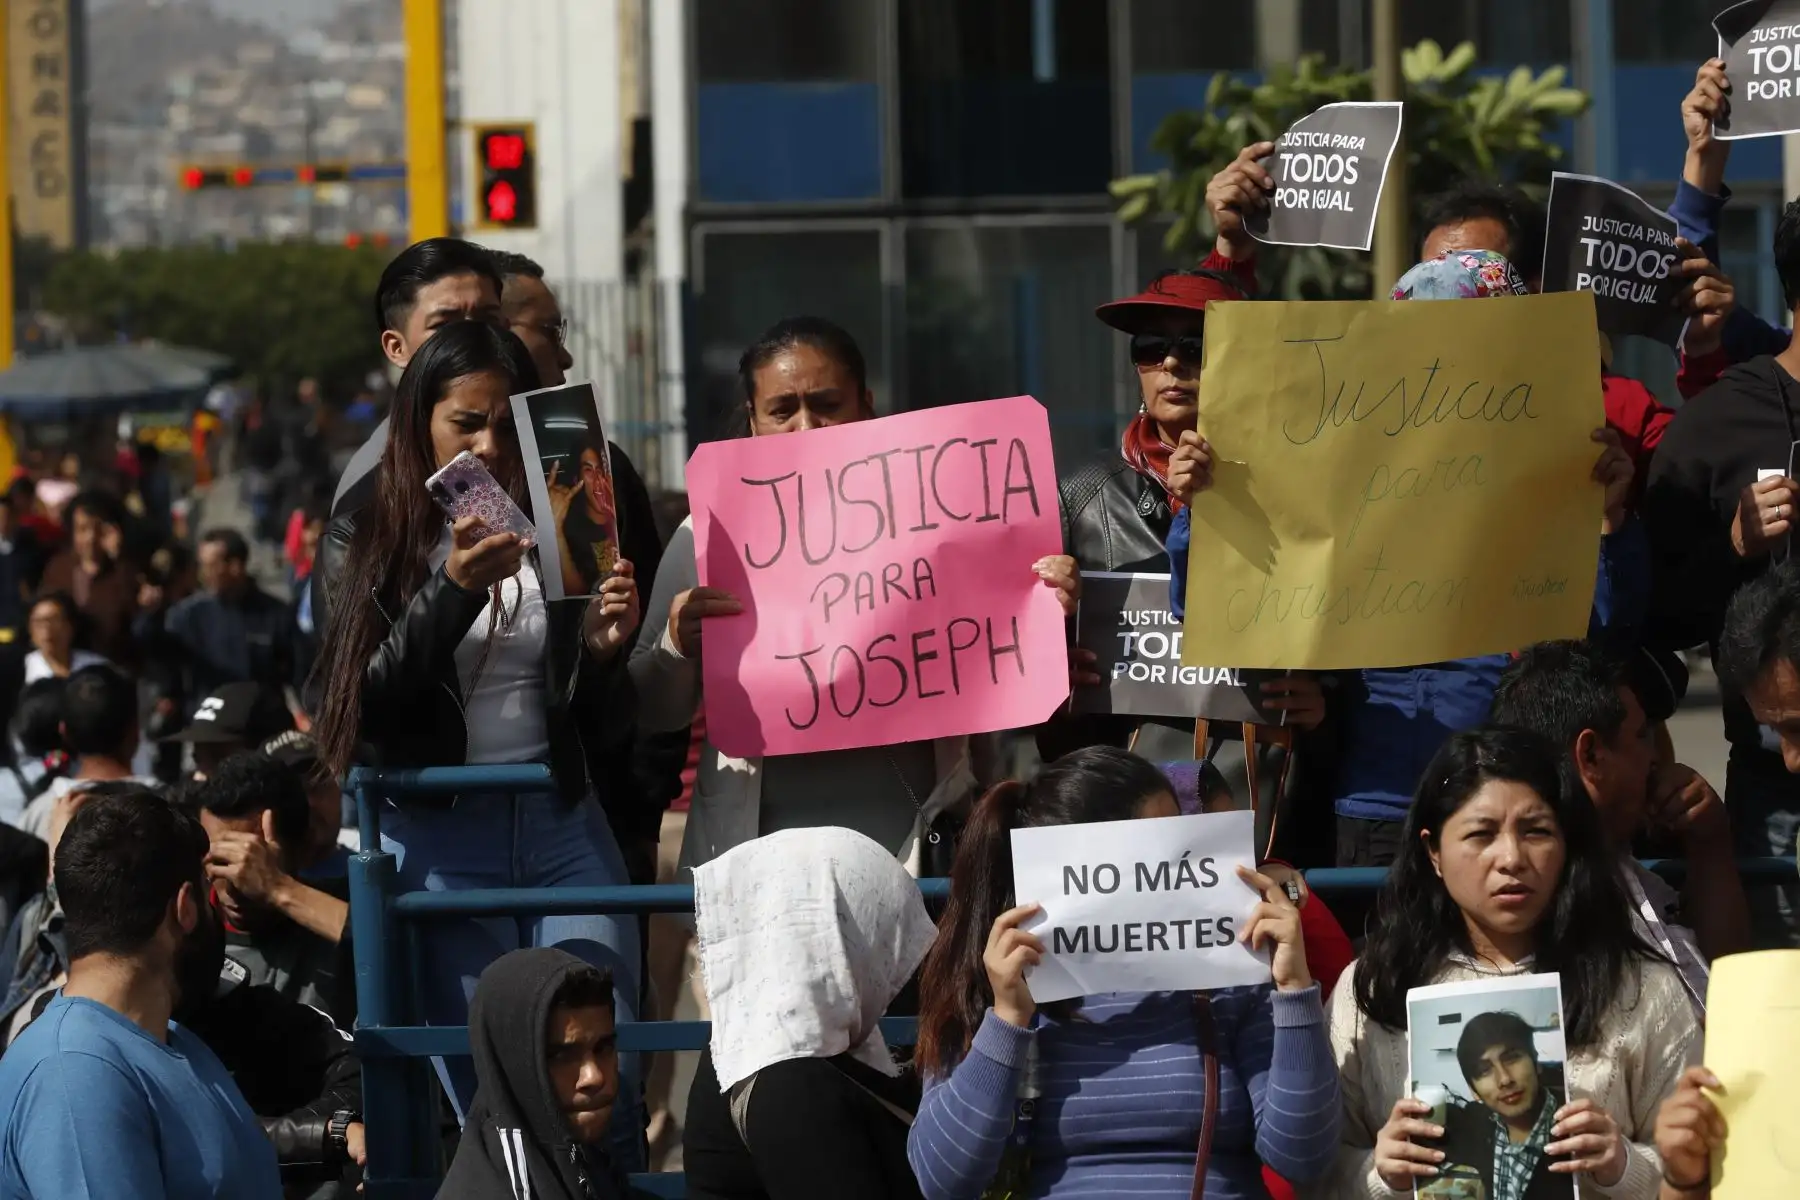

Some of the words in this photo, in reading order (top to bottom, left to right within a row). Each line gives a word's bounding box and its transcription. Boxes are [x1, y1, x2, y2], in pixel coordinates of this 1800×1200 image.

[1747, 78, 1792, 101] POR
[1281, 131, 1330, 148] JUSTICIA
[1330, 134, 1366, 150] PARA
[1280, 152, 1360, 185] TODOS
[1274, 187, 1310, 209] POR
[1311, 189, 1354, 212] IGUAL
[1582, 215, 1643, 241] JUSTICIA
[1580, 237, 1677, 279] TODOS
[1576, 272, 1610, 297] POR
[1610, 278, 1658, 304] IGUAL
[1283, 334, 1539, 445] Justicia
[740, 437, 1040, 569] JUSTICIA
[1345, 453, 1486, 549] para
[810, 557, 936, 623] PARA
[1118, 610, 1183, 626] JUSTIC
[774, 615, 1025, 731] JOSEPH
[1112, 662, 1167, 684] POR
[1171, 665, 1248, 687] IGUAL
[1062, 863, 1121, 896] NO
[1134, 850, 1219, 893] MÁS
[1053, 916, 1236, 955] MUERTES
